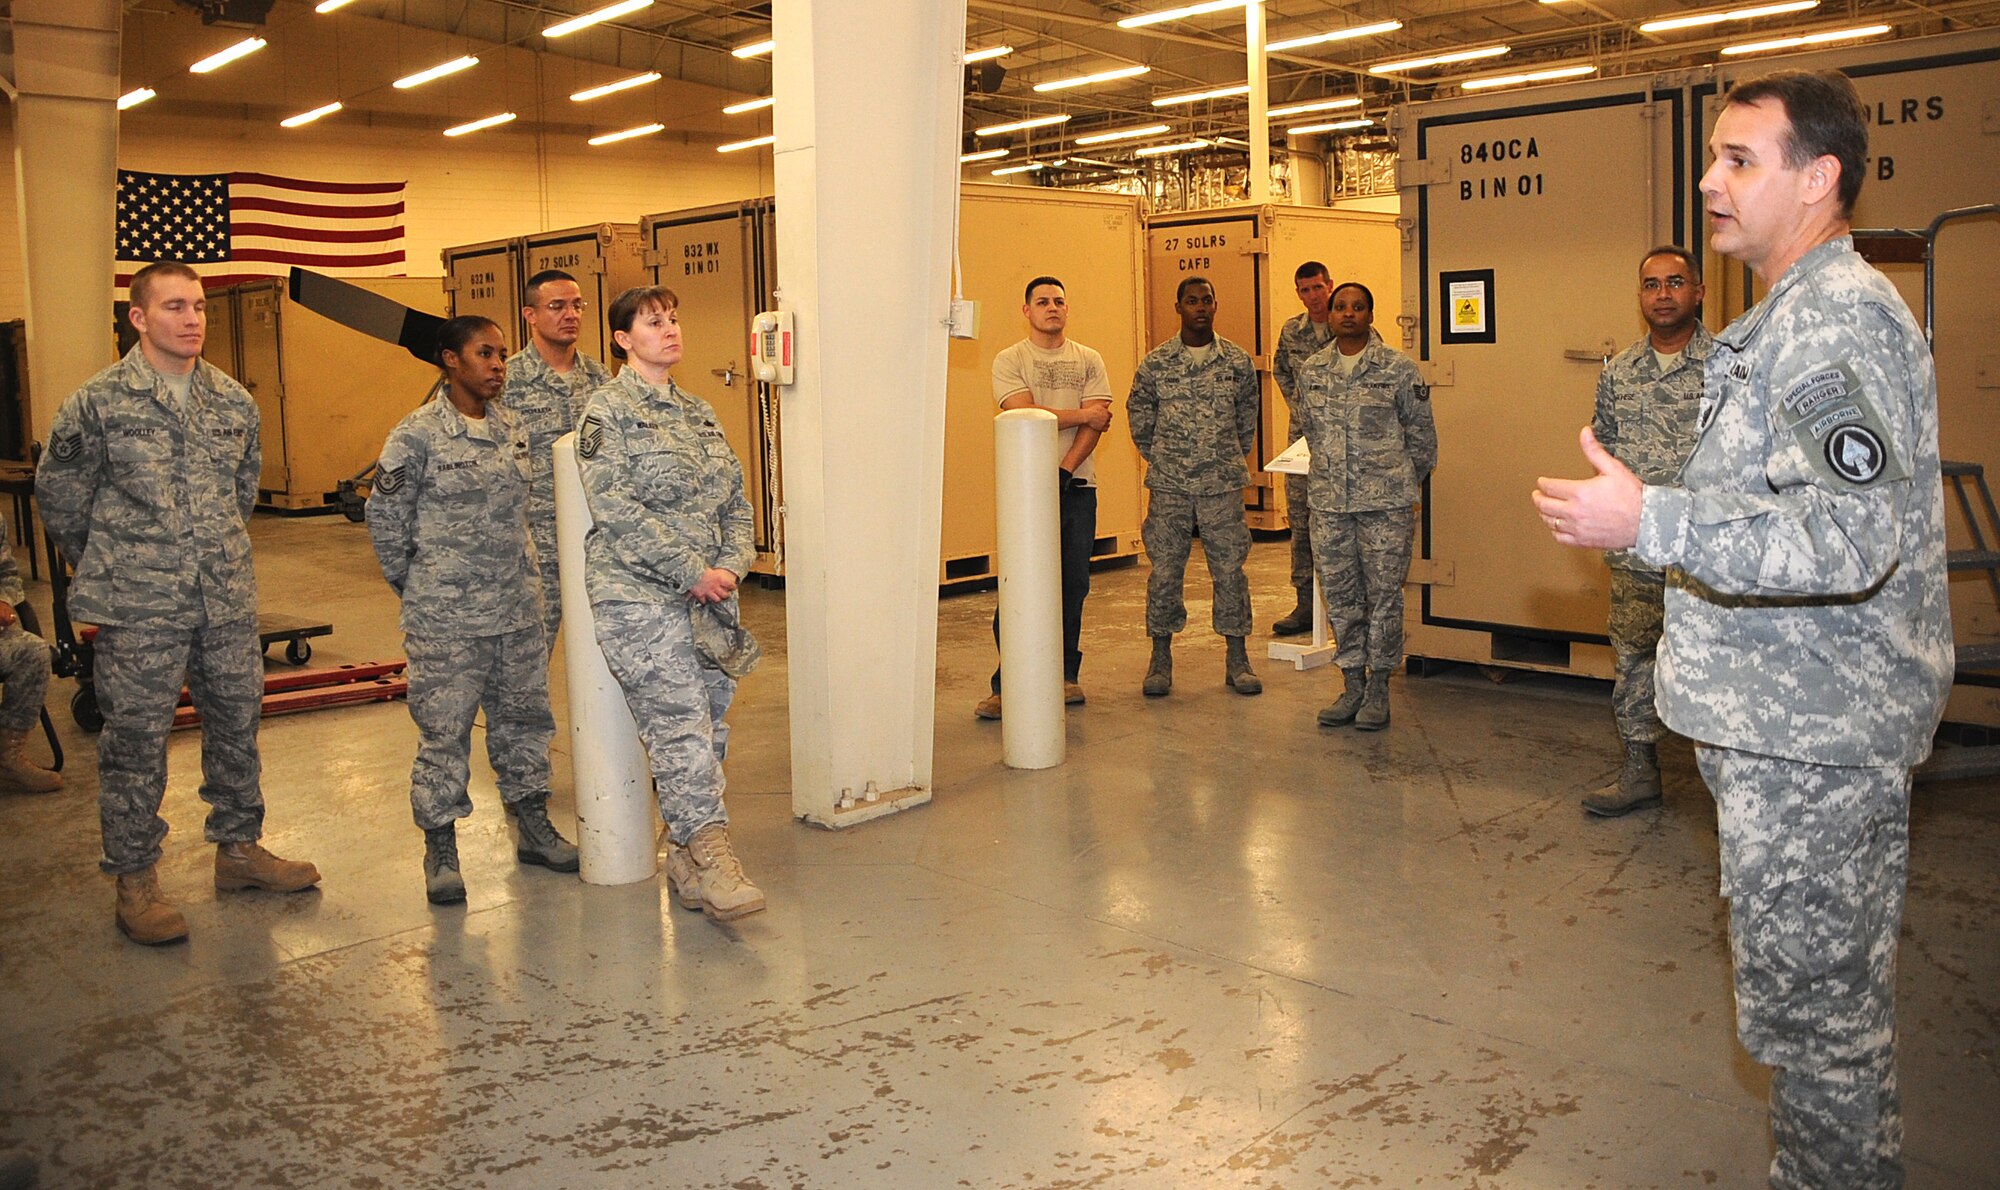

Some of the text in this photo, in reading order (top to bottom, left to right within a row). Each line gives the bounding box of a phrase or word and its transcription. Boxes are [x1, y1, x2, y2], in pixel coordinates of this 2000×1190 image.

[1461, 137, 1539, 164] 840CA
[1460, 174, 1543, 200] BIN 01
[684, 241, 720, 258] 832 WX
[1164, 235, 1227, 252] 27 SOLRS
[539, 254, 580, 270] 27 SOLRS
[684, 259, 719, 275] BIN 01
[1178, 257, 1211, 271] CAFB
[471, 286, 495, 300] BIN 01
[1784, 371, 1840, 404] SPECIAL FORCES
[1802, 385, 1839, 412] RANGER
[1814, 406, 1859, 433] AIRBORNE
[122, 428, 156, 437] WOOLLEY
